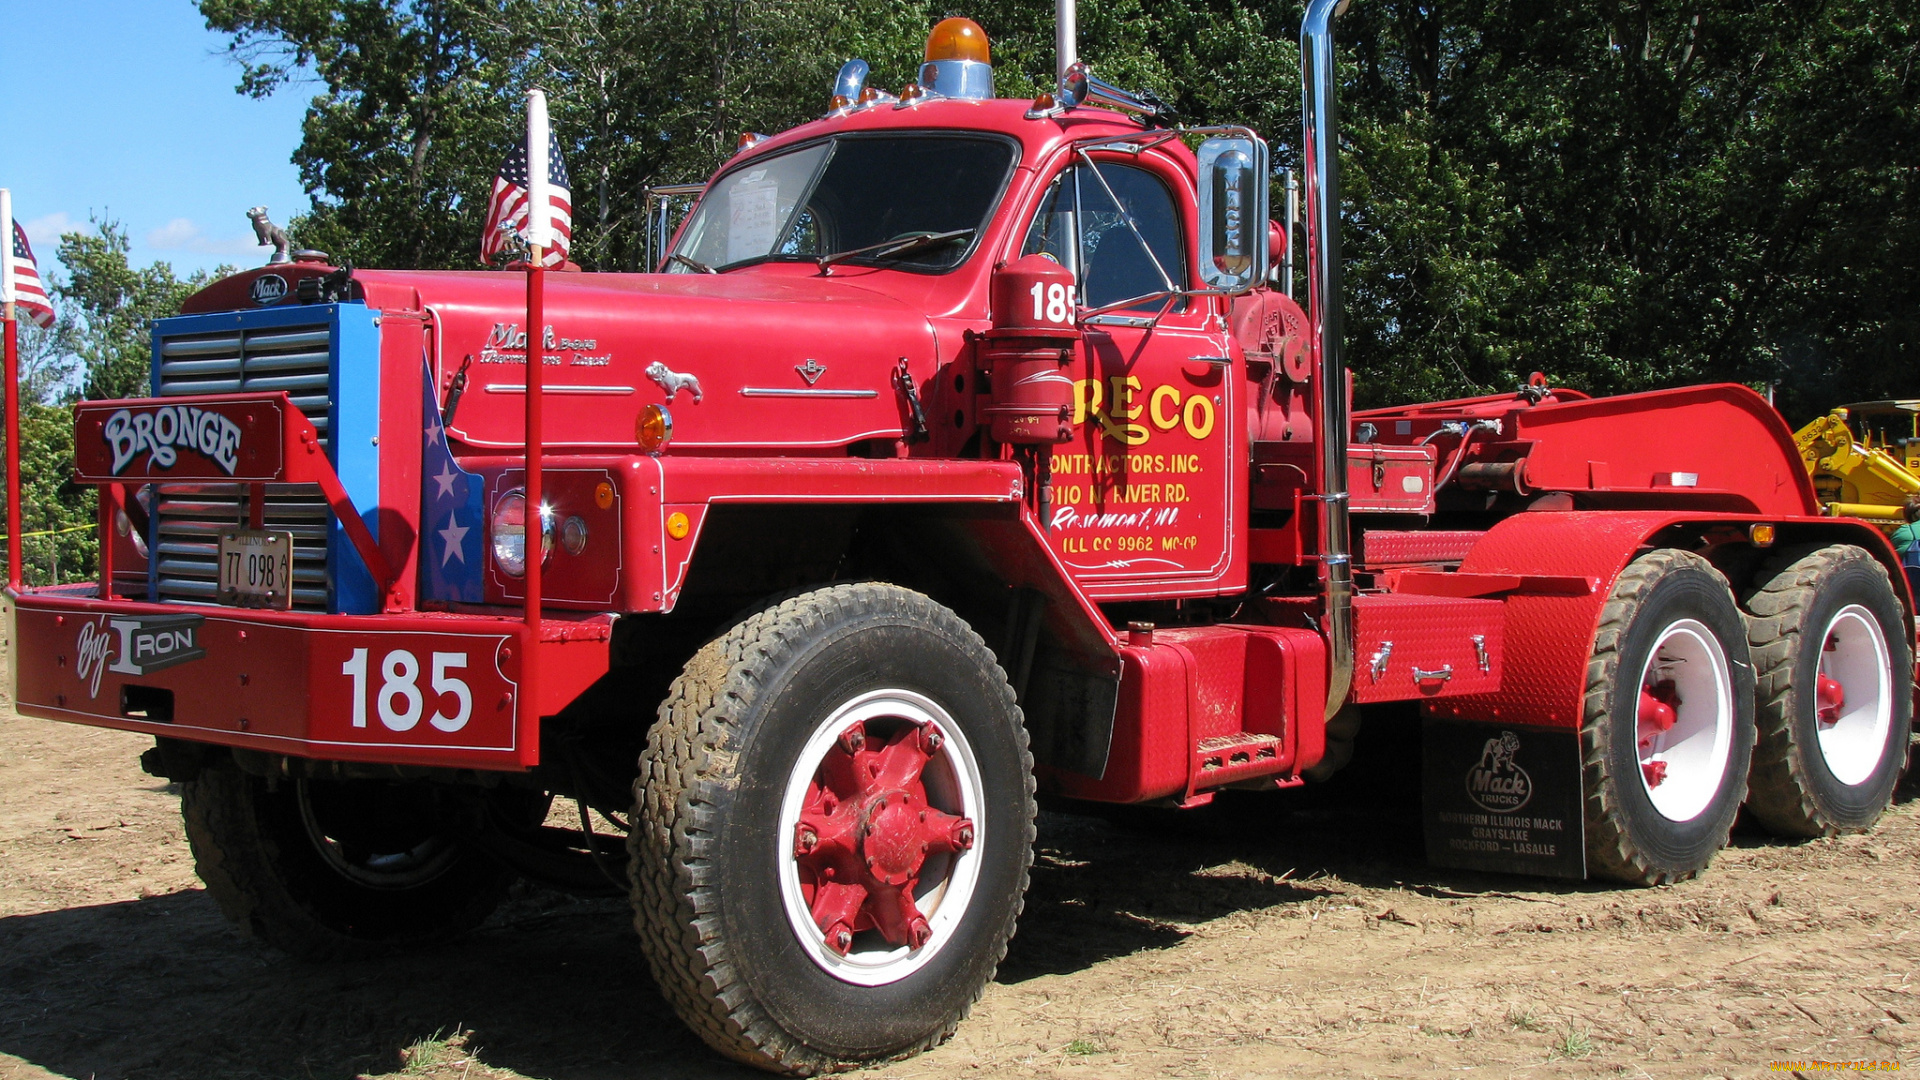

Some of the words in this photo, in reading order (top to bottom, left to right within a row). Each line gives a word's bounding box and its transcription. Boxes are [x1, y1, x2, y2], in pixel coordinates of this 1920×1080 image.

[252, 278, 281, 298] Mack
[1030, 281, 1075, 326] 185
[484, 323, 556, 350] Mak
[1073, 375, 1215, 445] RECO
[105, 405, 242, 476] BRONGE
[1113, 484, 1161, 504] RIVER
[1165, 483, 1190, 503] RD.
[1063, 537, 1089, 554] ILL
[1093, 536, 1113, 551] CC
[1118, 536, 1154, 551] 9962
[227, 551, 242, 585] 77
[249, 553, 275, 588] 098
[77, 613, 115, 699] Big
[109, 619, 193, 676] IRON
[342, 647, 473, 733] 185
[1472, 769, 1527, 795] Mack
[1480, 793, 1519, 805] TRUCKS
[1439, 811, 1488, 826] NORTHERN
[1490, 815, 1531, 829] ILLINOIS
[1533, 818, 1563, 831] MACK
[1449, 838, 1499, 852] ROCKFORD
[1513, 842, 1556, 856] LASALLE
[1472, 827, 1529, 842] GRAYSLAKE
